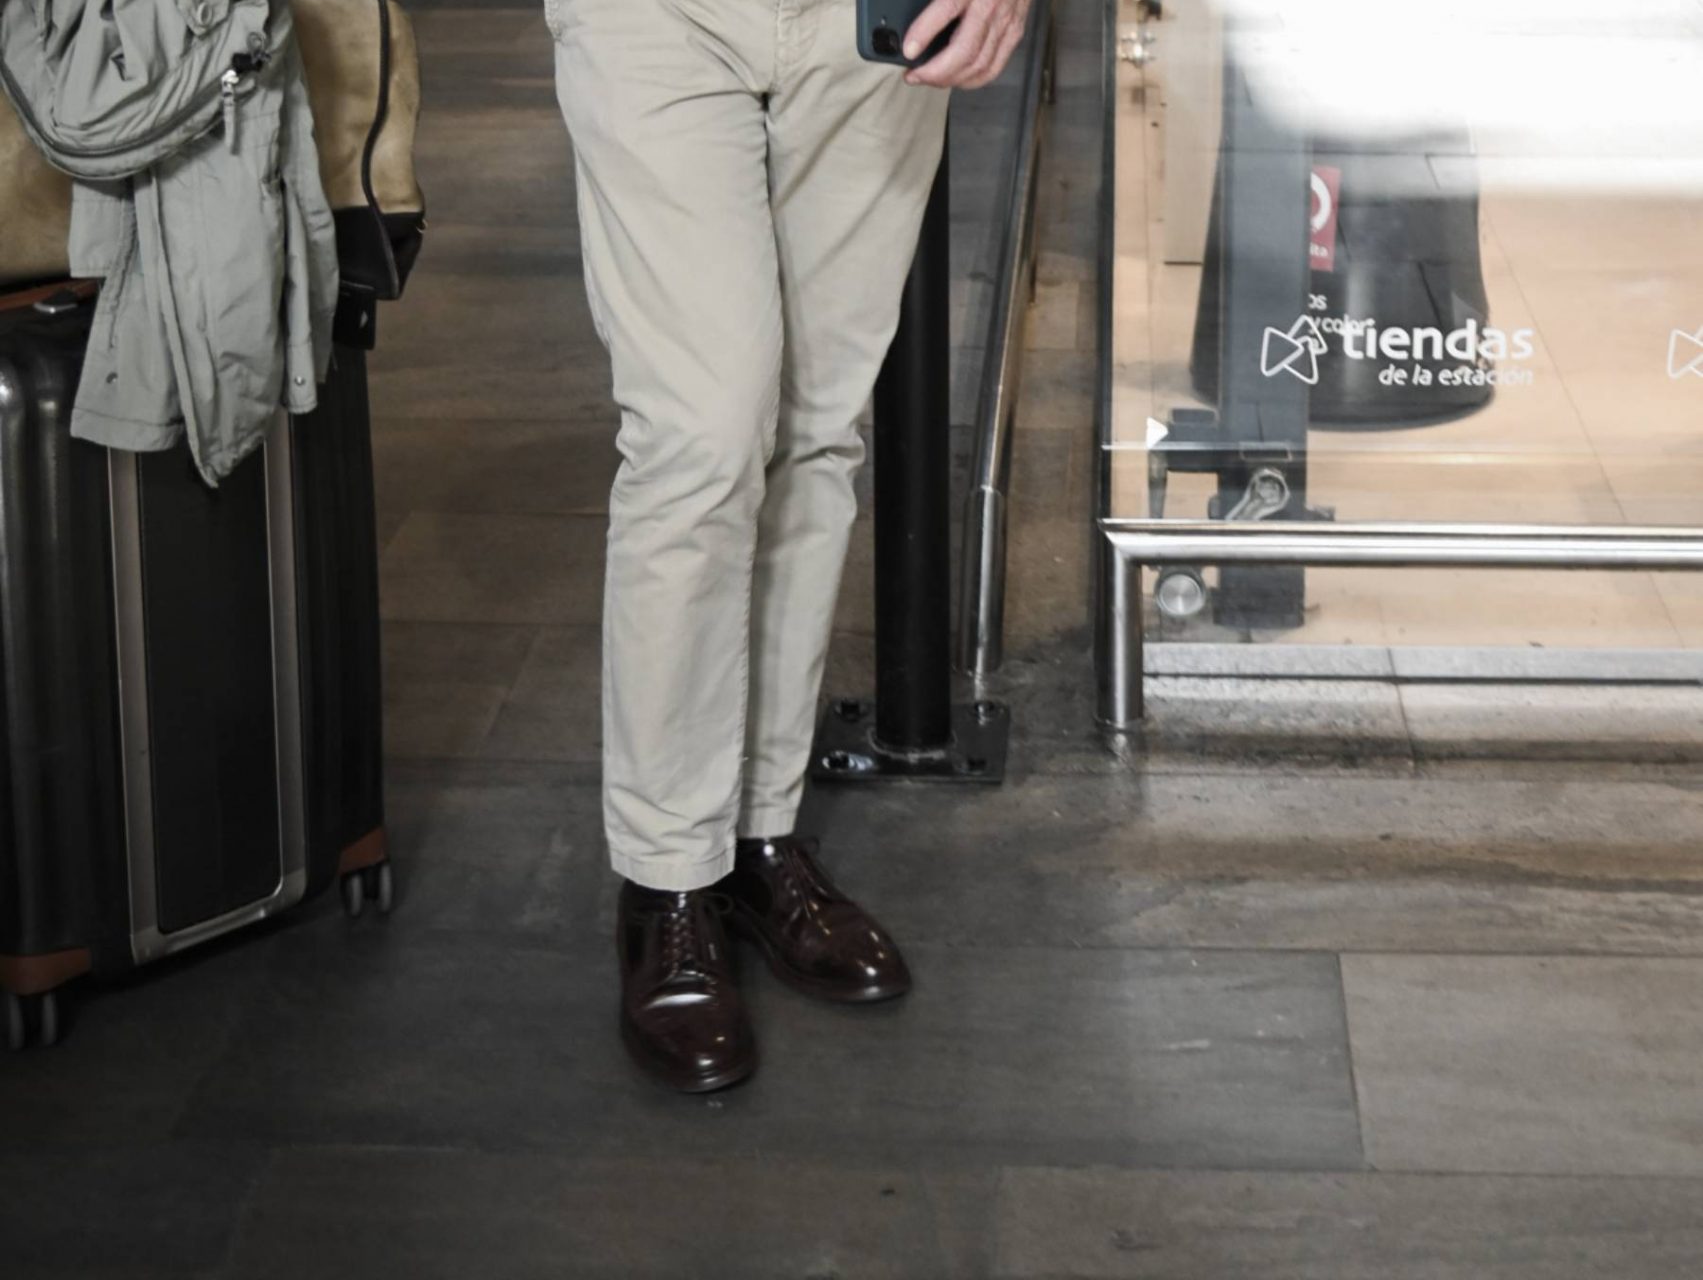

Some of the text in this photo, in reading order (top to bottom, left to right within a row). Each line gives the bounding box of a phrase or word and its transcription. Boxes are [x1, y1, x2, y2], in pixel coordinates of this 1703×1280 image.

[1344, 319, 1534, 361] tiendas
[1378, 364, 1534, 386] de la estación
